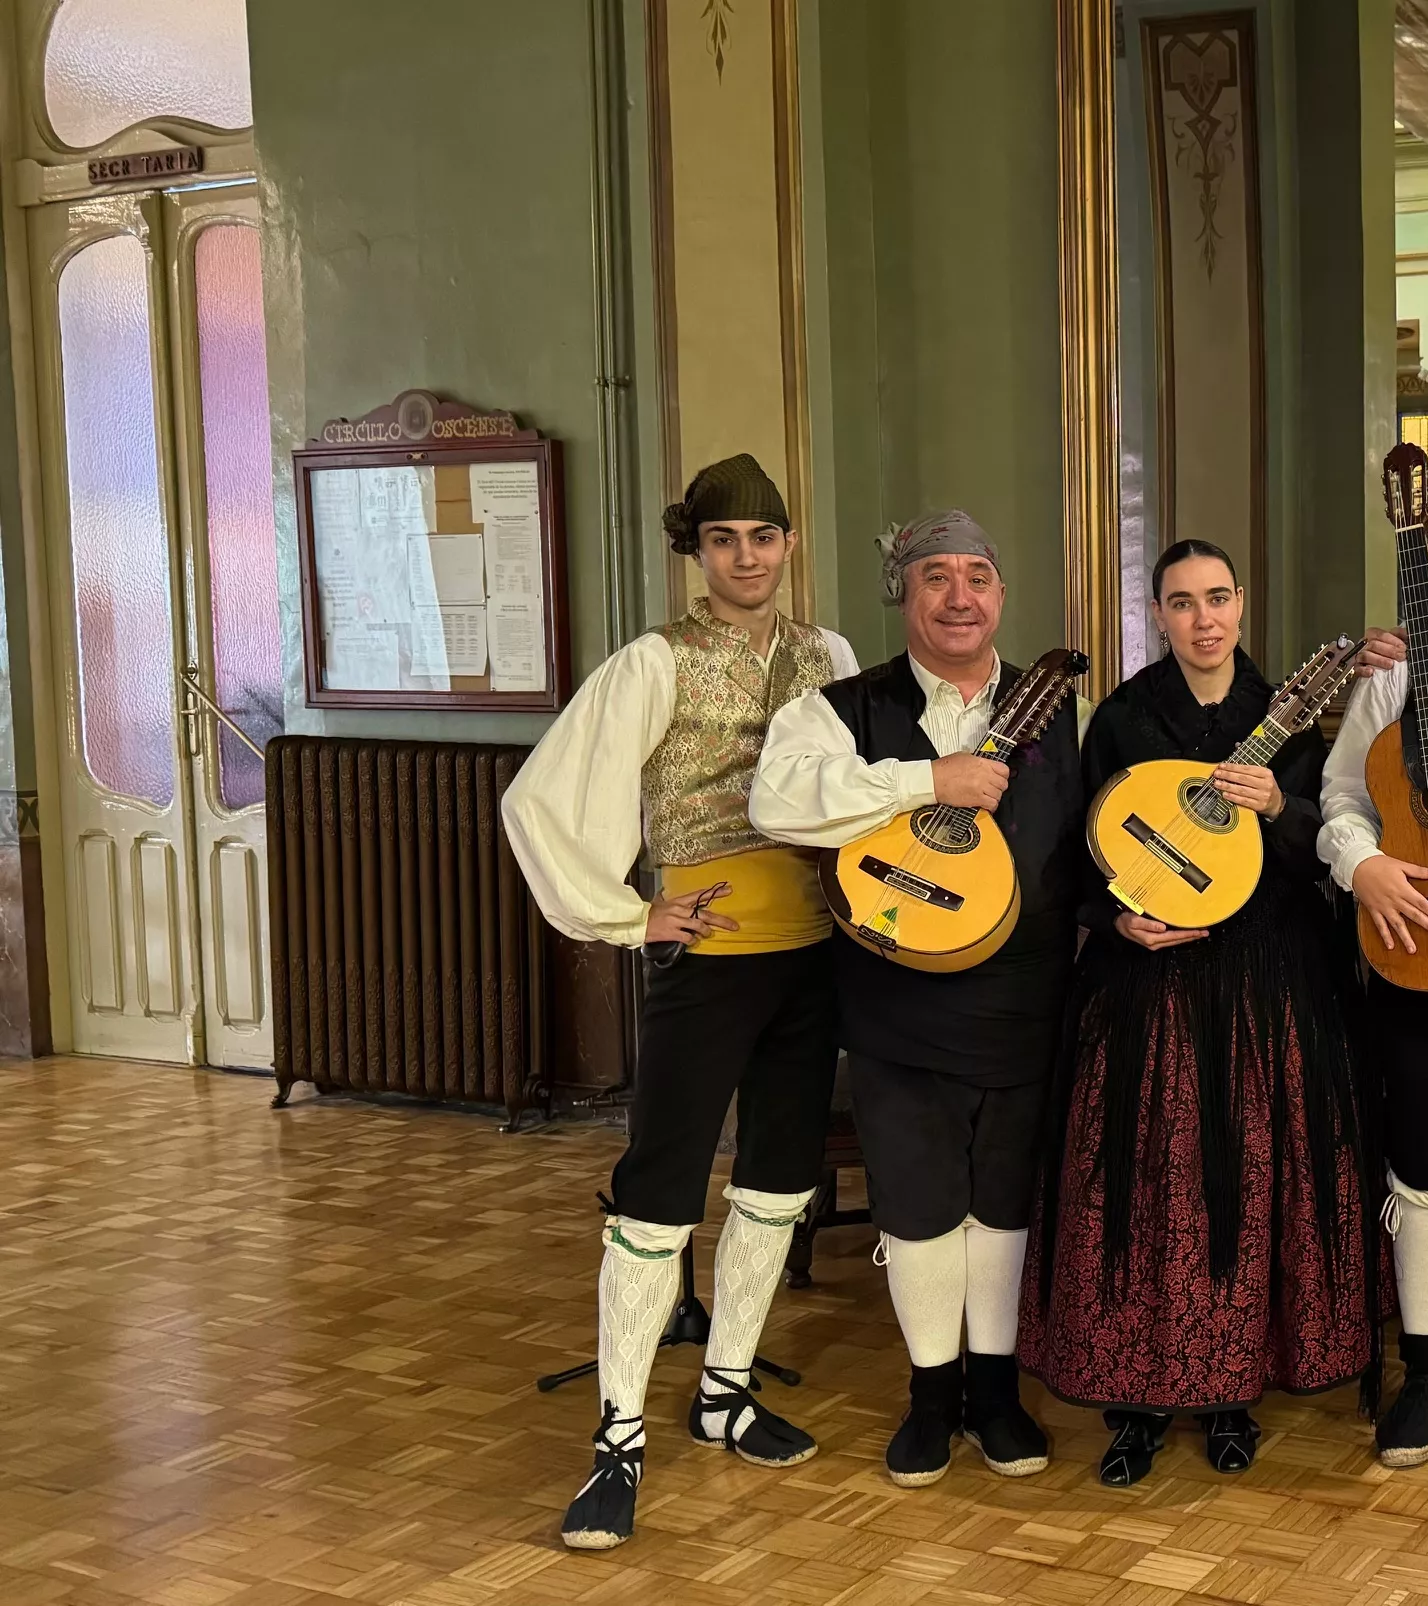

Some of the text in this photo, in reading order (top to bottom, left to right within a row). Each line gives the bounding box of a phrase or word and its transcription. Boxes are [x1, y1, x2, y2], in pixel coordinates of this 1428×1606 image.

[88, 151, 198, 180] SECRTARIA
[323, 413, 514, 443] CIRCULO OSCENSE
